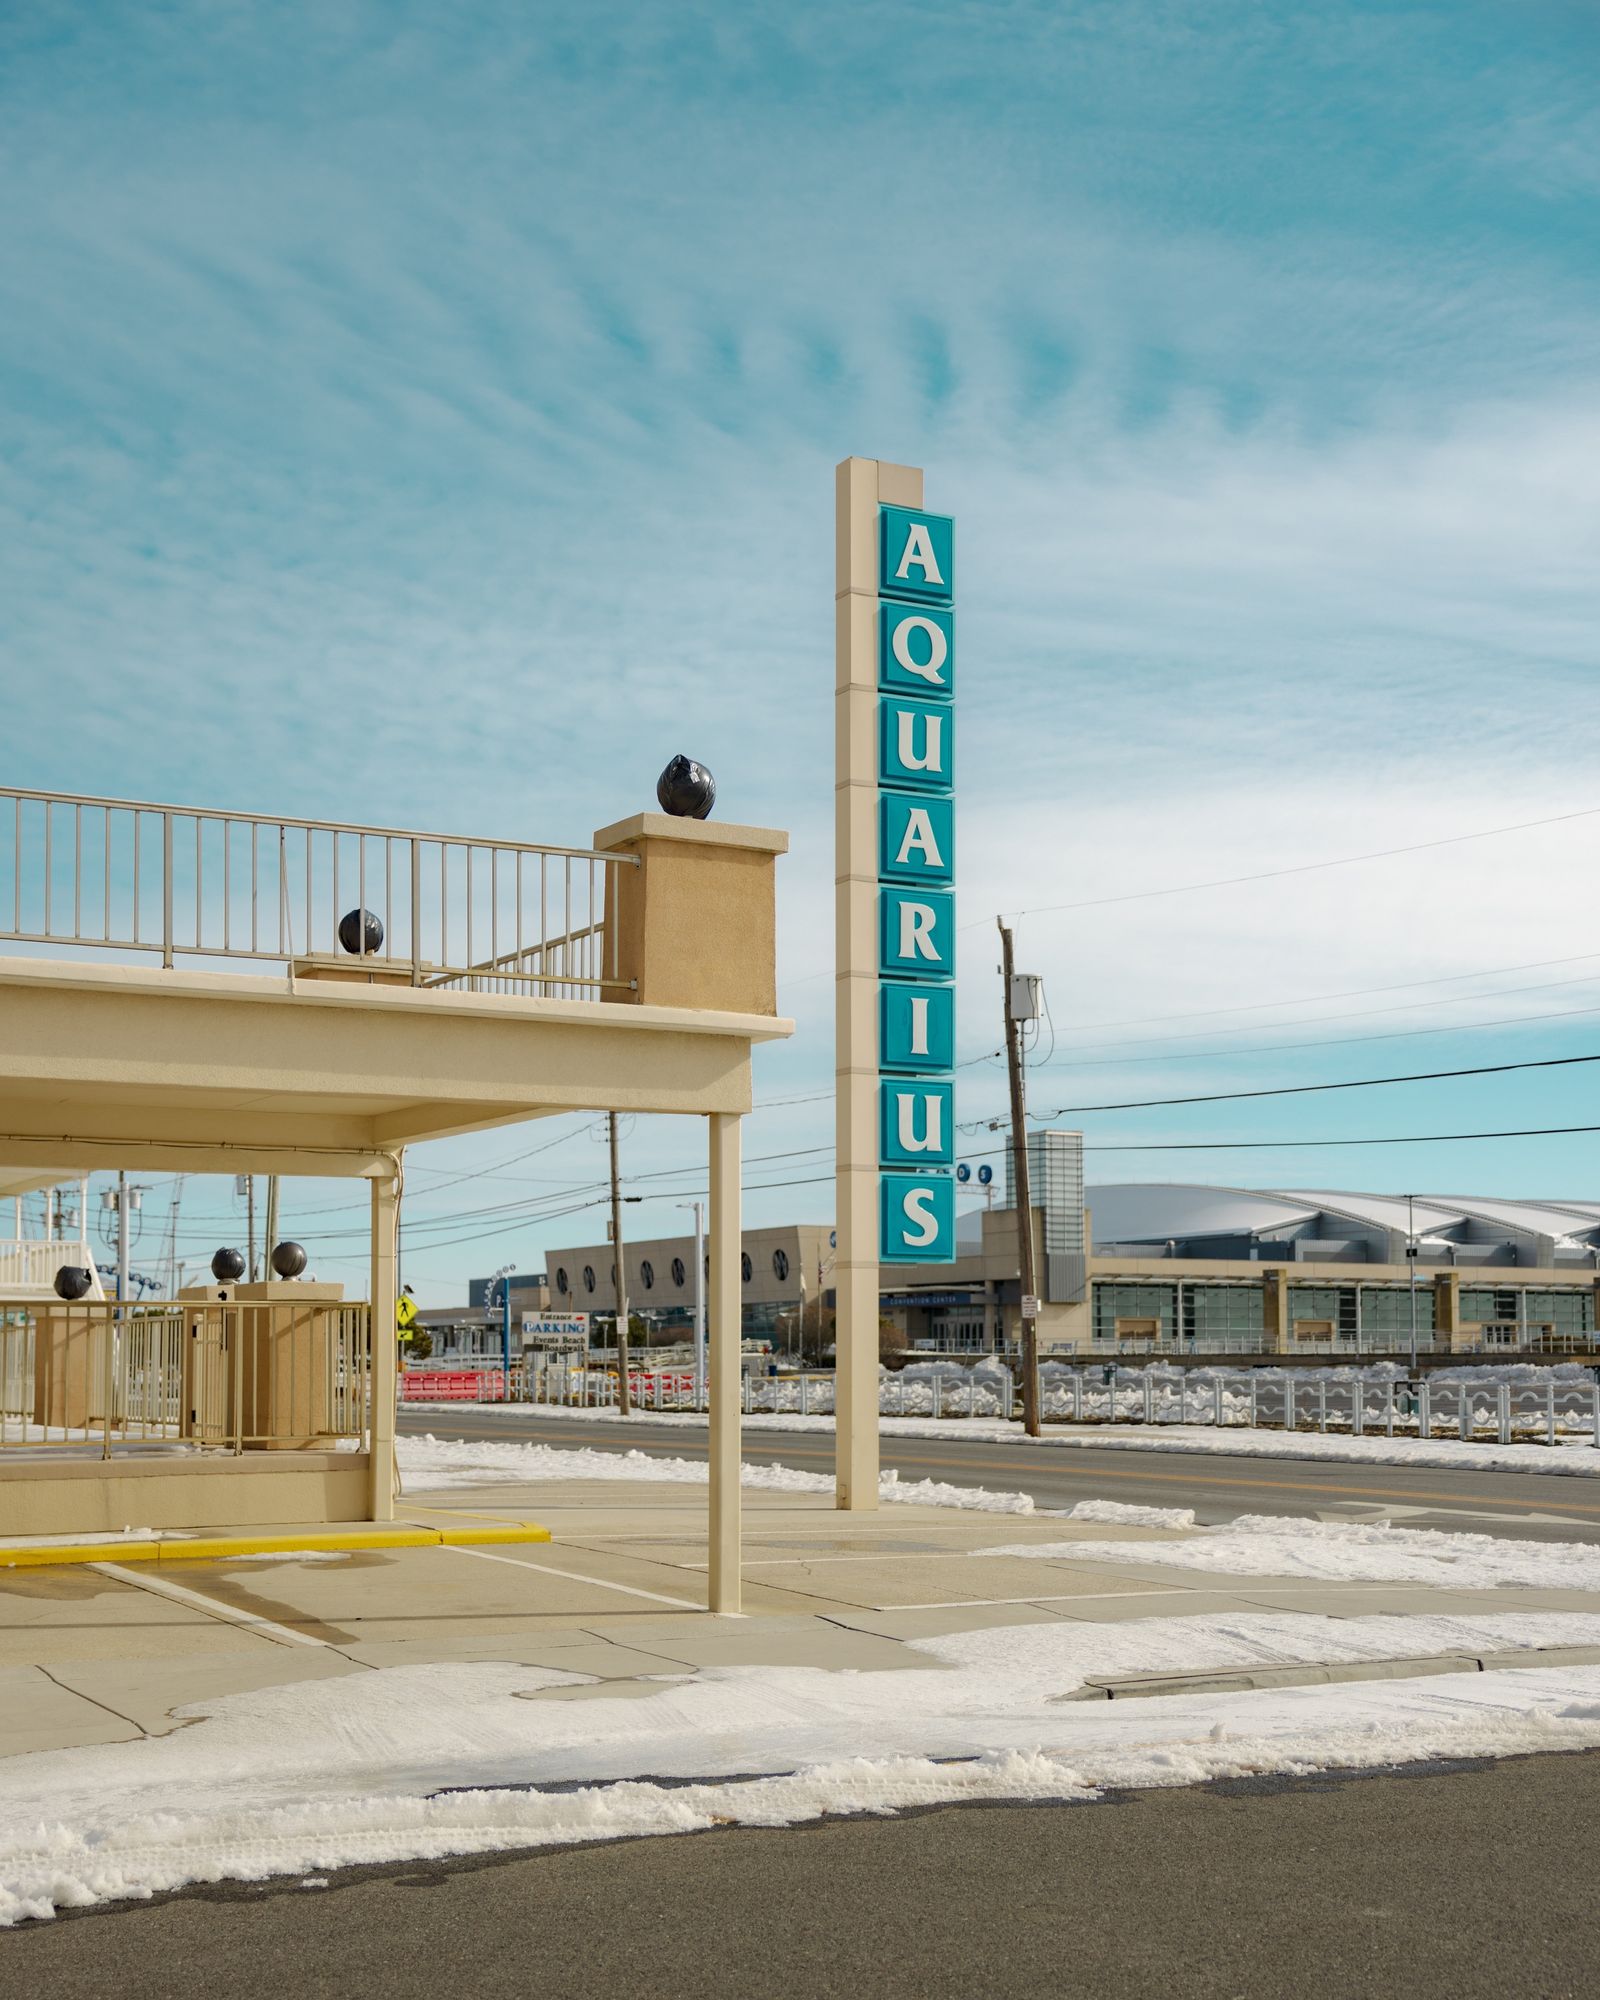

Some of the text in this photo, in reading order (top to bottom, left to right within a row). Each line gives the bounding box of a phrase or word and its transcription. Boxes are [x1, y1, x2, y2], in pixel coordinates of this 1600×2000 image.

[893, 524, 947, 1248] AQUARIUS
[890, 1297, 929, 1305] CONVENTION
[523, 1321, 585, 1333] PARKING
[544, 1344, 584, 1352] Boardwalk
